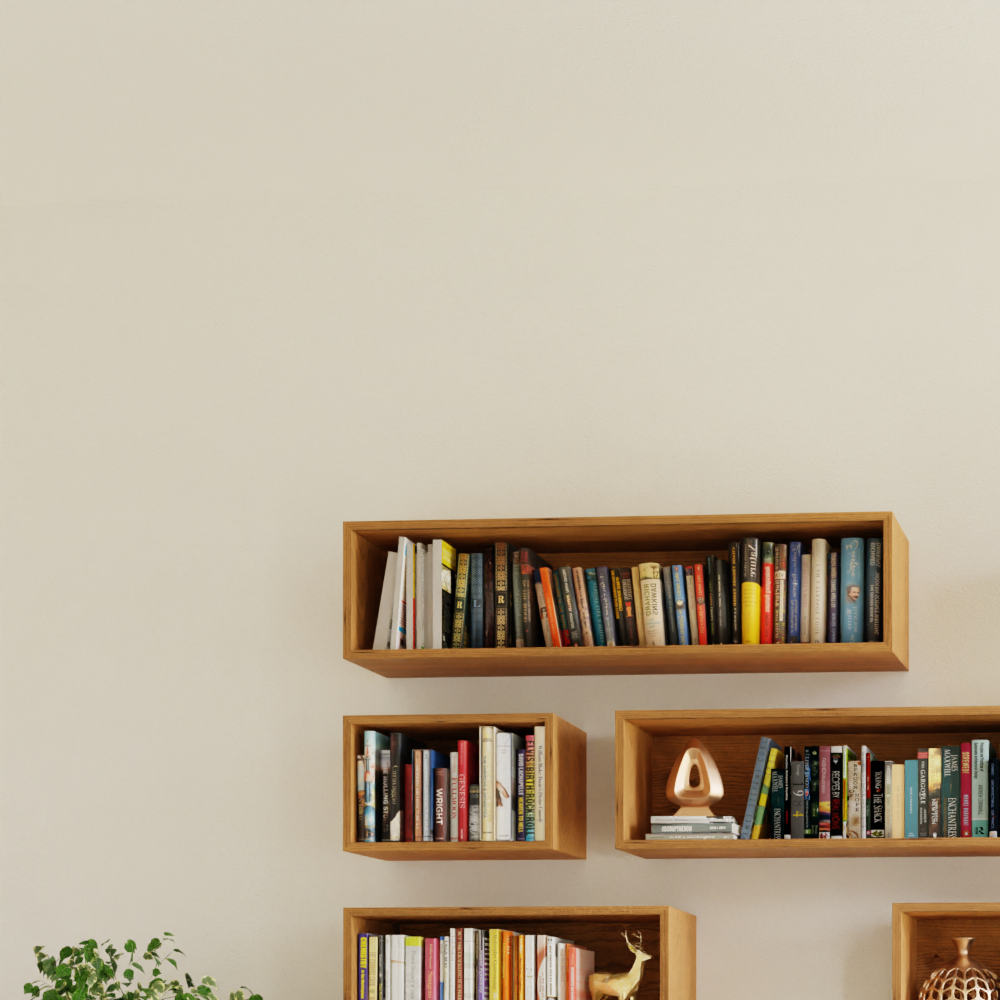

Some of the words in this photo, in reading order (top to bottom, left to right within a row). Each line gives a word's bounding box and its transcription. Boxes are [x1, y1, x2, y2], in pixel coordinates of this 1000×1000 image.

[456, 601, 463, 610] R
[472, 600, 481, 608] L
[497, 594, 505, 604] R
[526, 740, 534, 761] ELVIS
[526, 767, 534, 790] BIRTH
[832, 771, 840, 791] RECIPES
[526, 794, 534, 813] ROCK
[832, 799, 840, 811] REAL
[832, 812, 840, 829] MOMS
[874, 805, 882, 823] SHACK
[526, 817, 534, 835] ROLL
